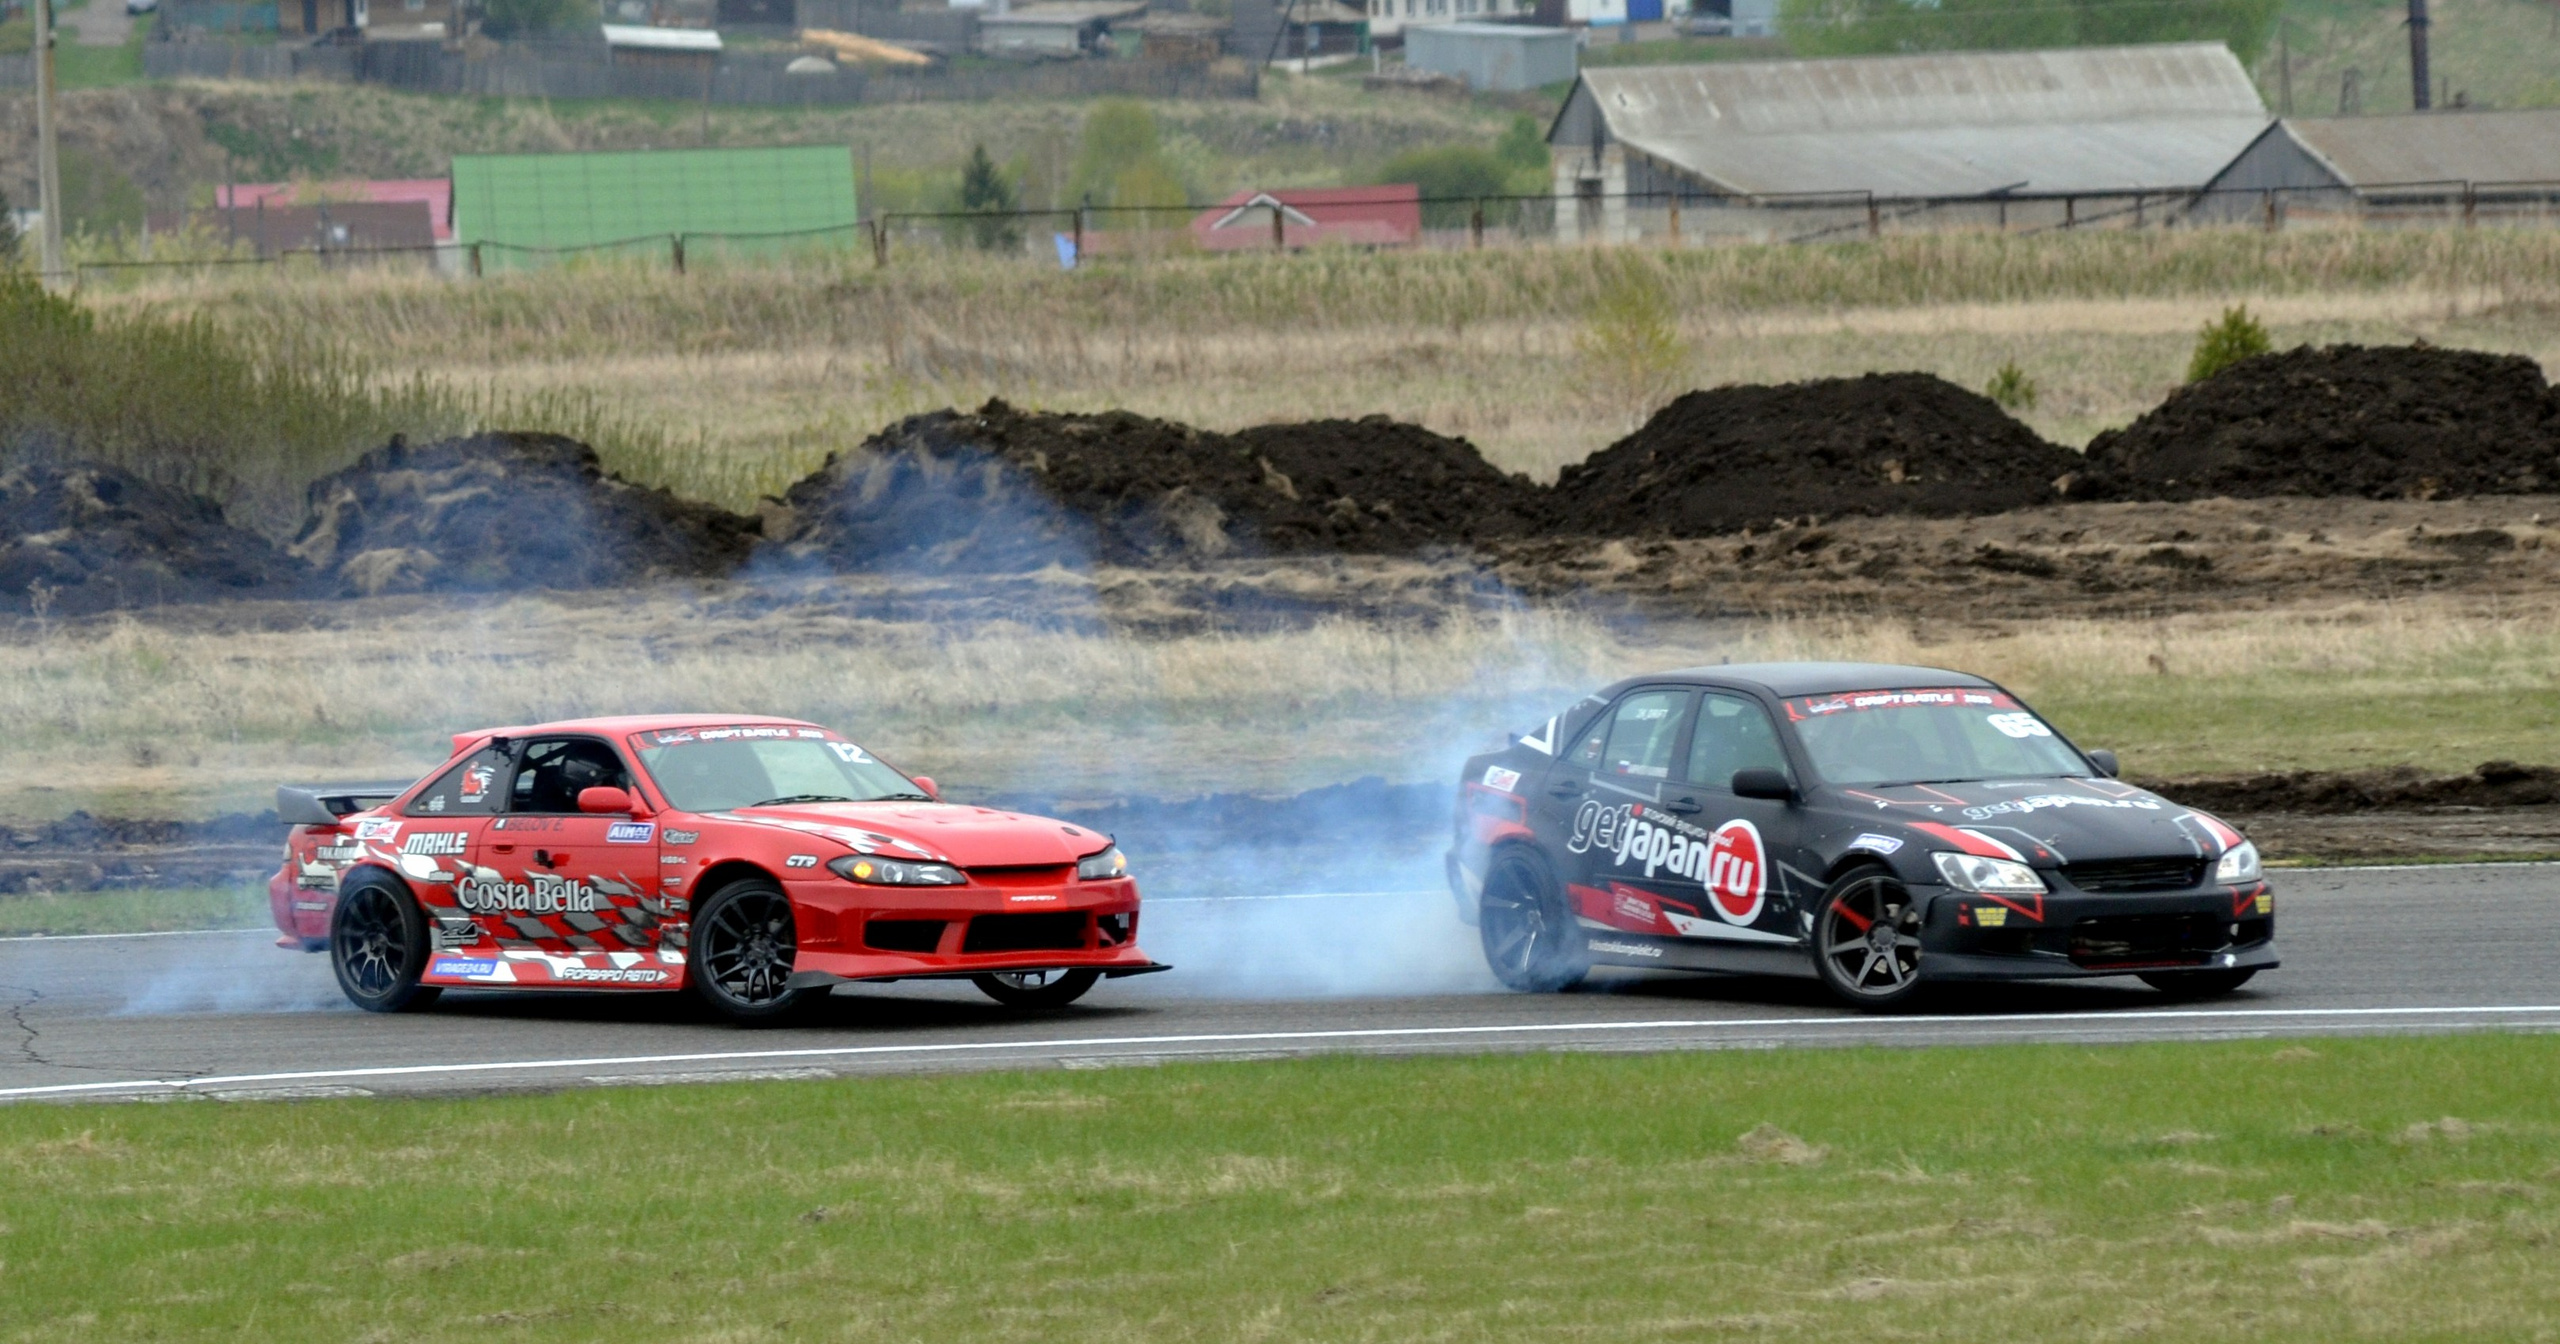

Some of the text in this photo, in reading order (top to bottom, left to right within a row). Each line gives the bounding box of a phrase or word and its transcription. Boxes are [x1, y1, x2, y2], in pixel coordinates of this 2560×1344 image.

[1987, 712, 2052, 738] 65
[827, 742, 873, 765] 12
[403, 832, 469, 854] MAHLE
[786, 854, 818, 868] CTR
[458, 876, 595, 912] Costa Bella
